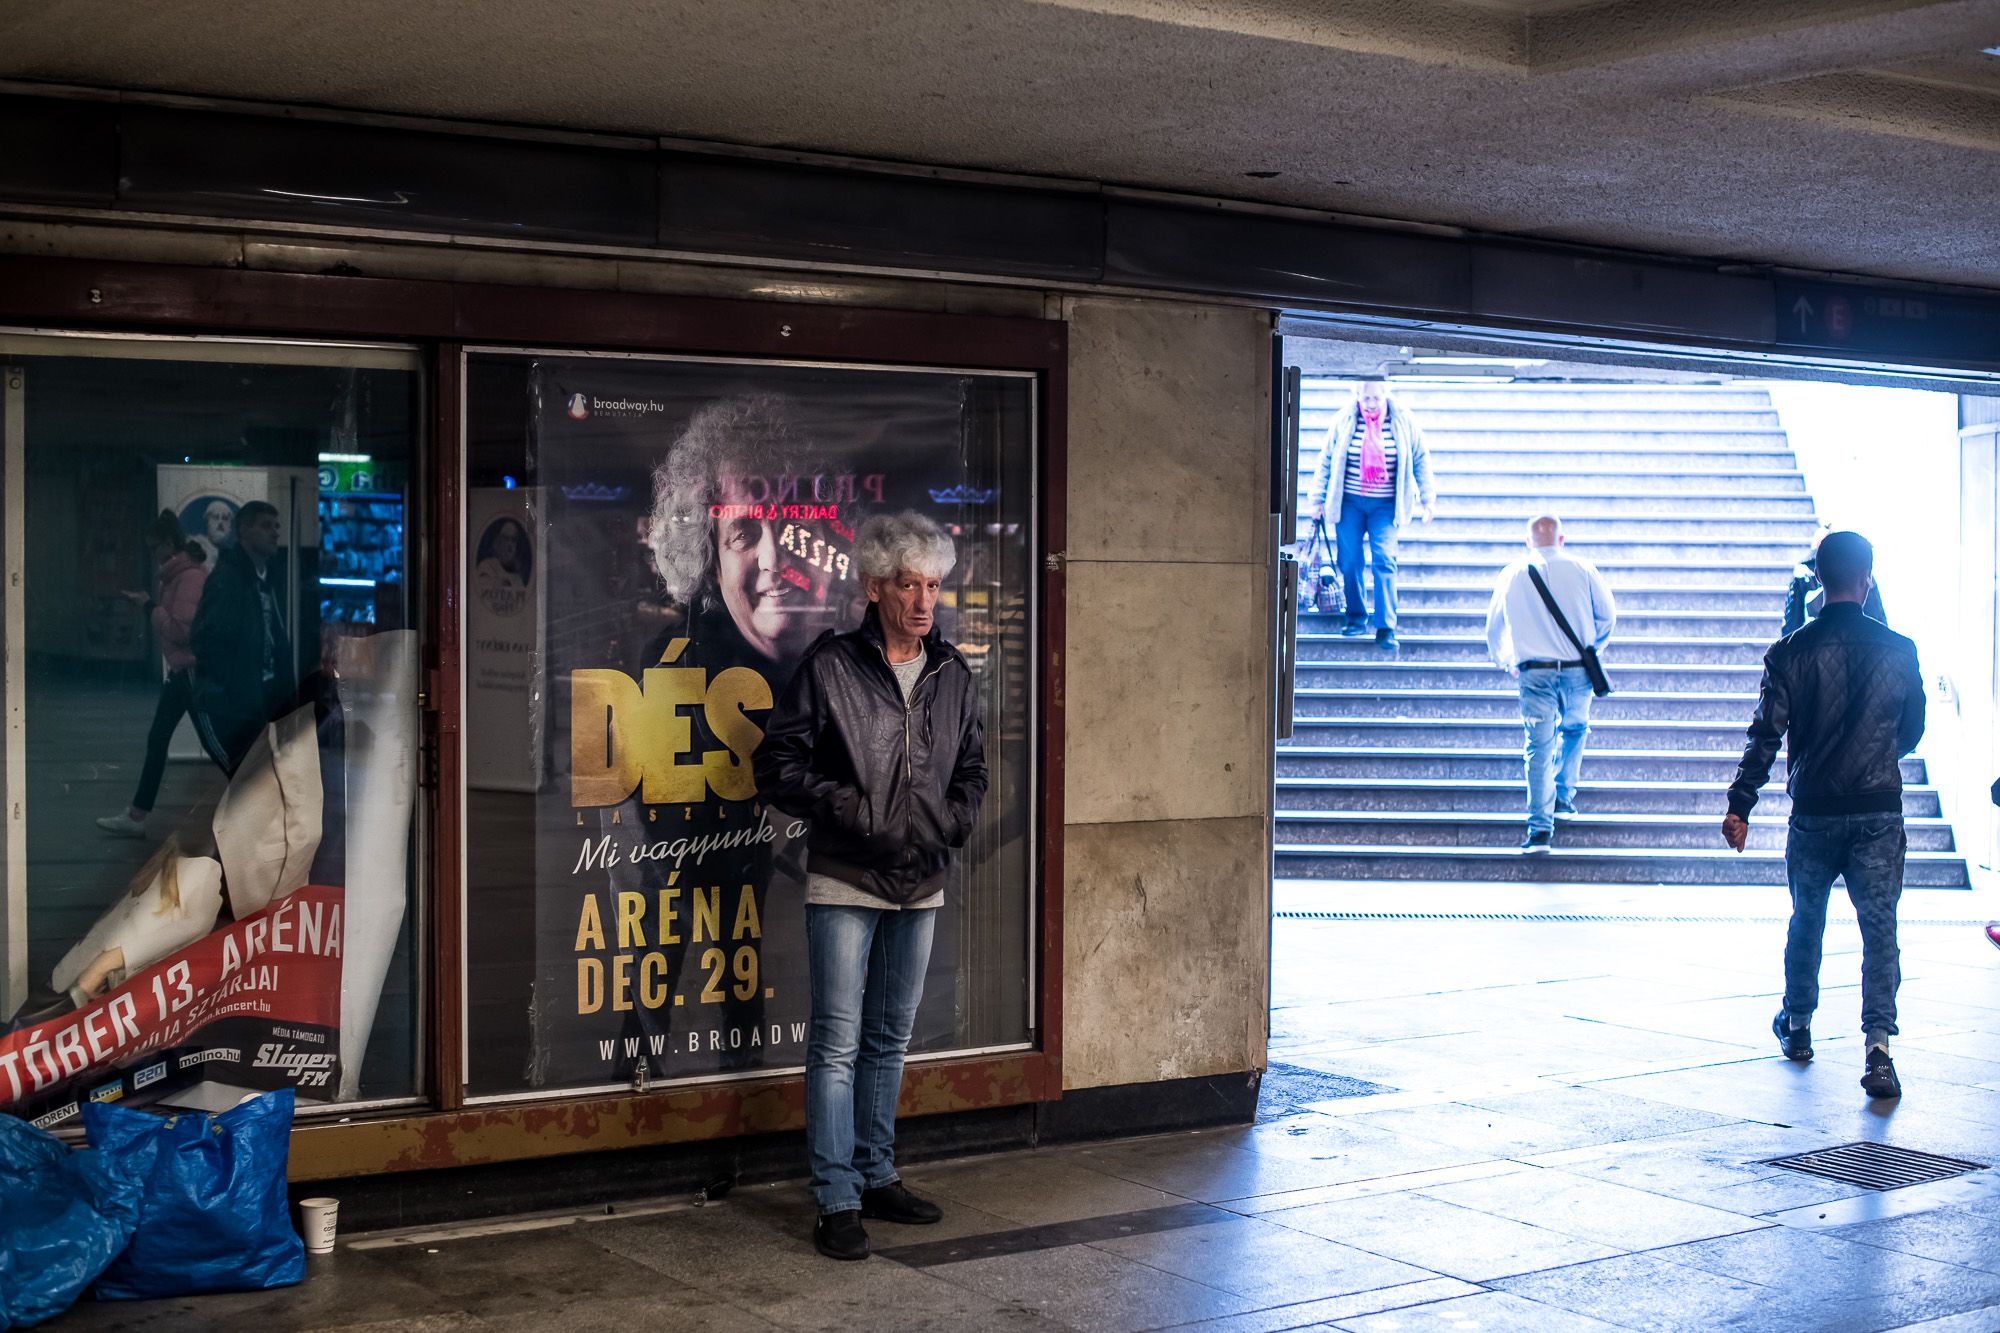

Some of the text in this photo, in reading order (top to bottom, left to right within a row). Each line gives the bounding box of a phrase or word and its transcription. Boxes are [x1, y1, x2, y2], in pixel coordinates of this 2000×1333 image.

[593, 396, 665, 414] broadway.hu
[571, 637, 774, 808] DÉS
[572, 809, 808, 875] Mi vagyunk a
[574, 870, 762, 952] ARÉNA
[152, 959, 206, 1023] 13.
[219, 896, 341, 982] ARÉNA
[577, 945, 775, 1016] DEC. 29.
[180, 1049, 240, 1069] molino.hu
[252, 1043, 337, 1077] Sláger
[272, 1026, 325, 1044] MÉDIA TÁMOGATÓ
[296, 1071, 332, 1086] FM
